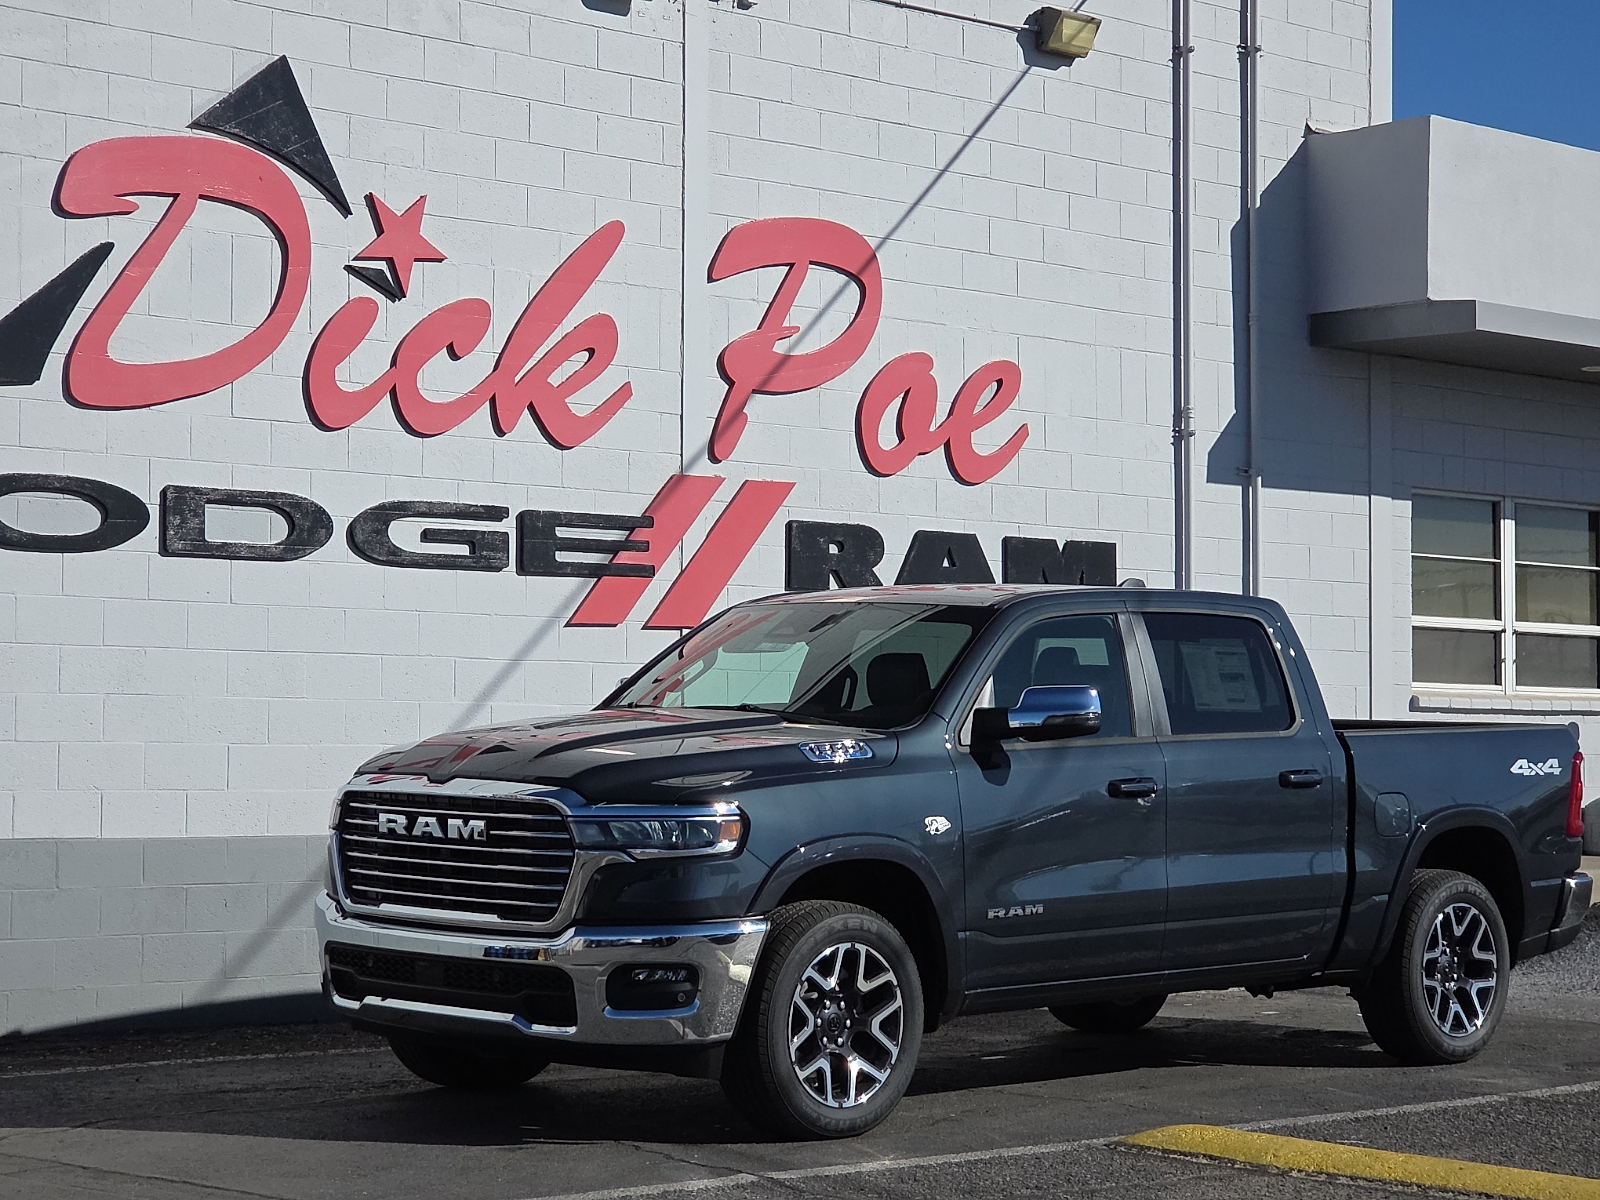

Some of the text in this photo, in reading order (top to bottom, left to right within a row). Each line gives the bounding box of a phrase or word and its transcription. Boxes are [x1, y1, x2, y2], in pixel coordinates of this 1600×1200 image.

[51, 135, 1029, 485] Dick Poe
[786, 520, 1116, 591] RAM
[1510, 758, 1562, 776] 4x4
[378, 812, 486, 841] RAM
[987, 903, 1044, 919] RAM
